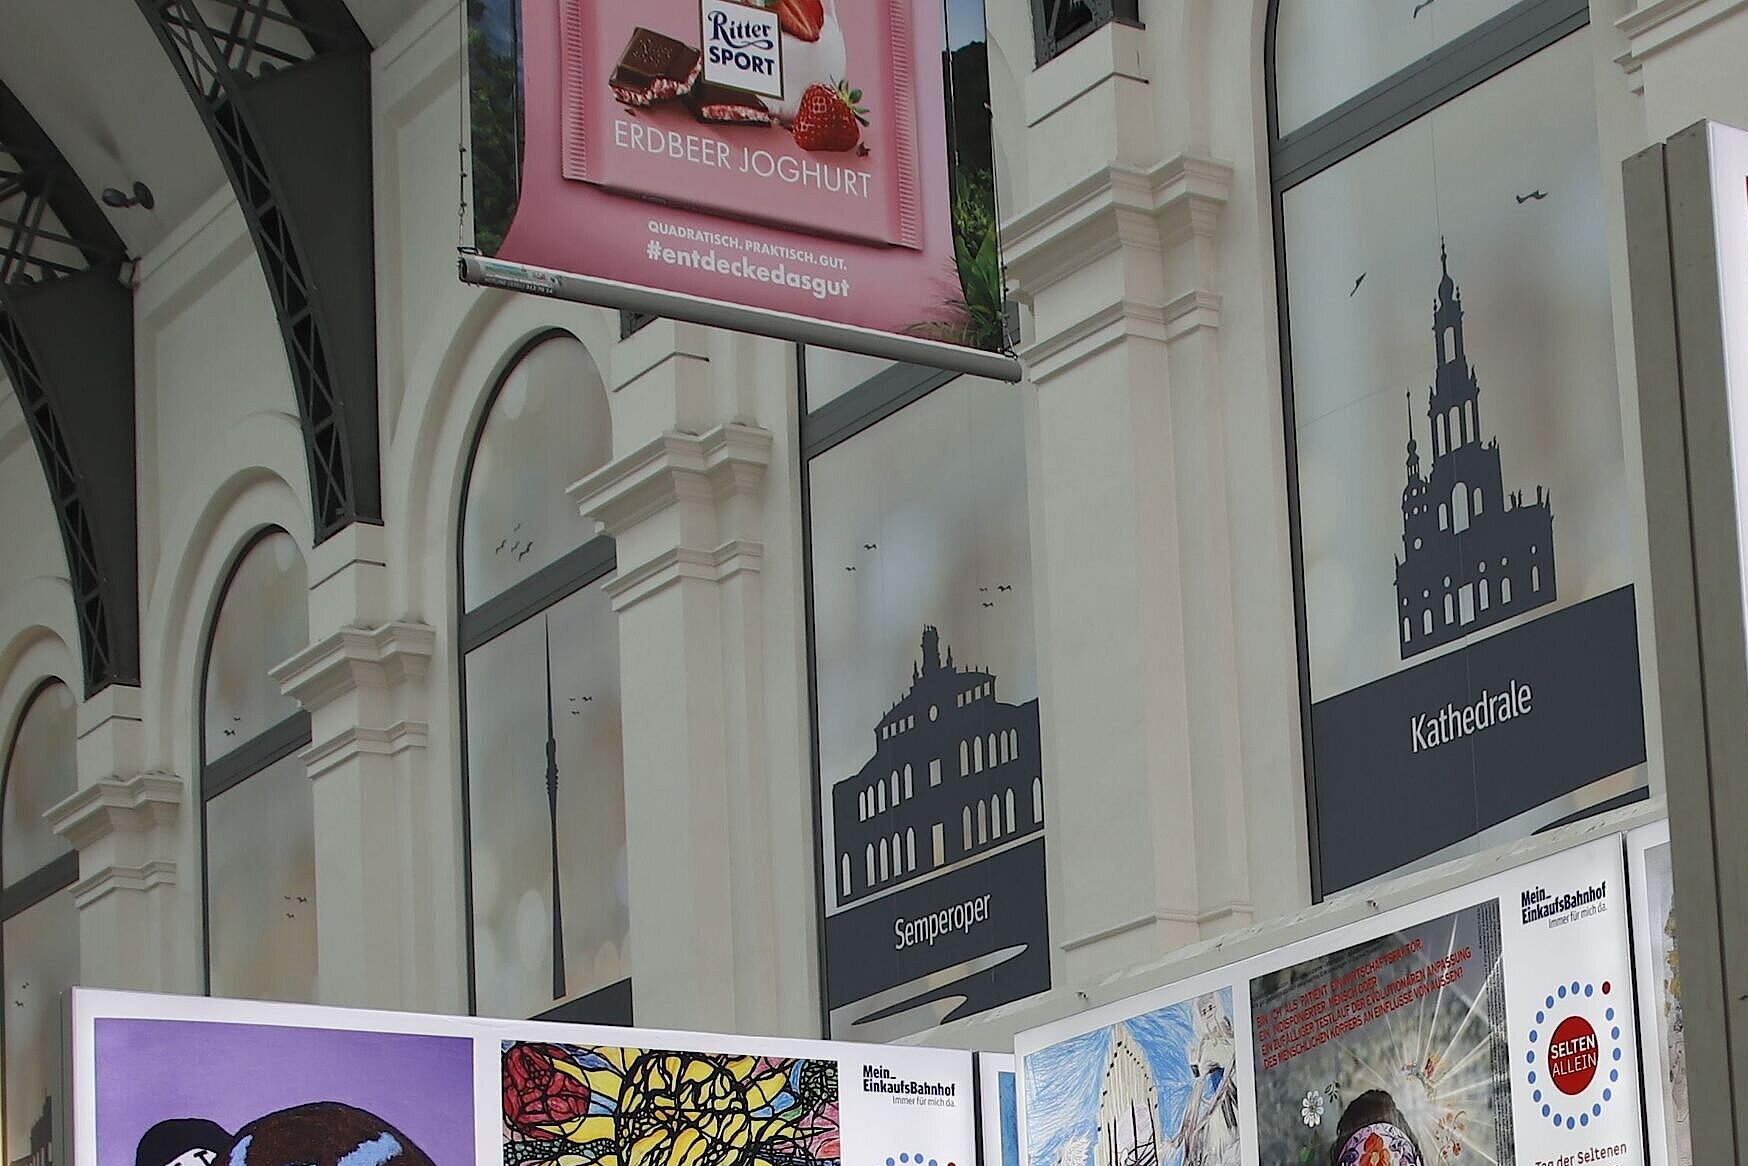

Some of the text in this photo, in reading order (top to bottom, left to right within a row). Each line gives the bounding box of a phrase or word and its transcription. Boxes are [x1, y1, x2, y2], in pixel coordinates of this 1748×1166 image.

[708, 10, 774, 51] Ritter
[709, 44, 775, 76] SPORT
[615, 119, 871, 198] ERDBEER JOGHURT
[648, 221, 846, 270] QUADRATISCH. PRAKTISCH. GUT.
[647, 240, 850, 298] #entdeckedasgut
[1411, 680, 1532, 753] Kathedrale
[895, 894, 991, 952] Semperoper
[1522, 881, 1606, 924] EinkaufsBahnhof
[1551, 1034, 1595, 1060] SELTEN
[1553, 1052, 1597, 1078] ALLEIN
[863, 1079, 955, 1096] EinkaufsBahnhof
[1578, 1142, 1627, 1166] Seltenen
